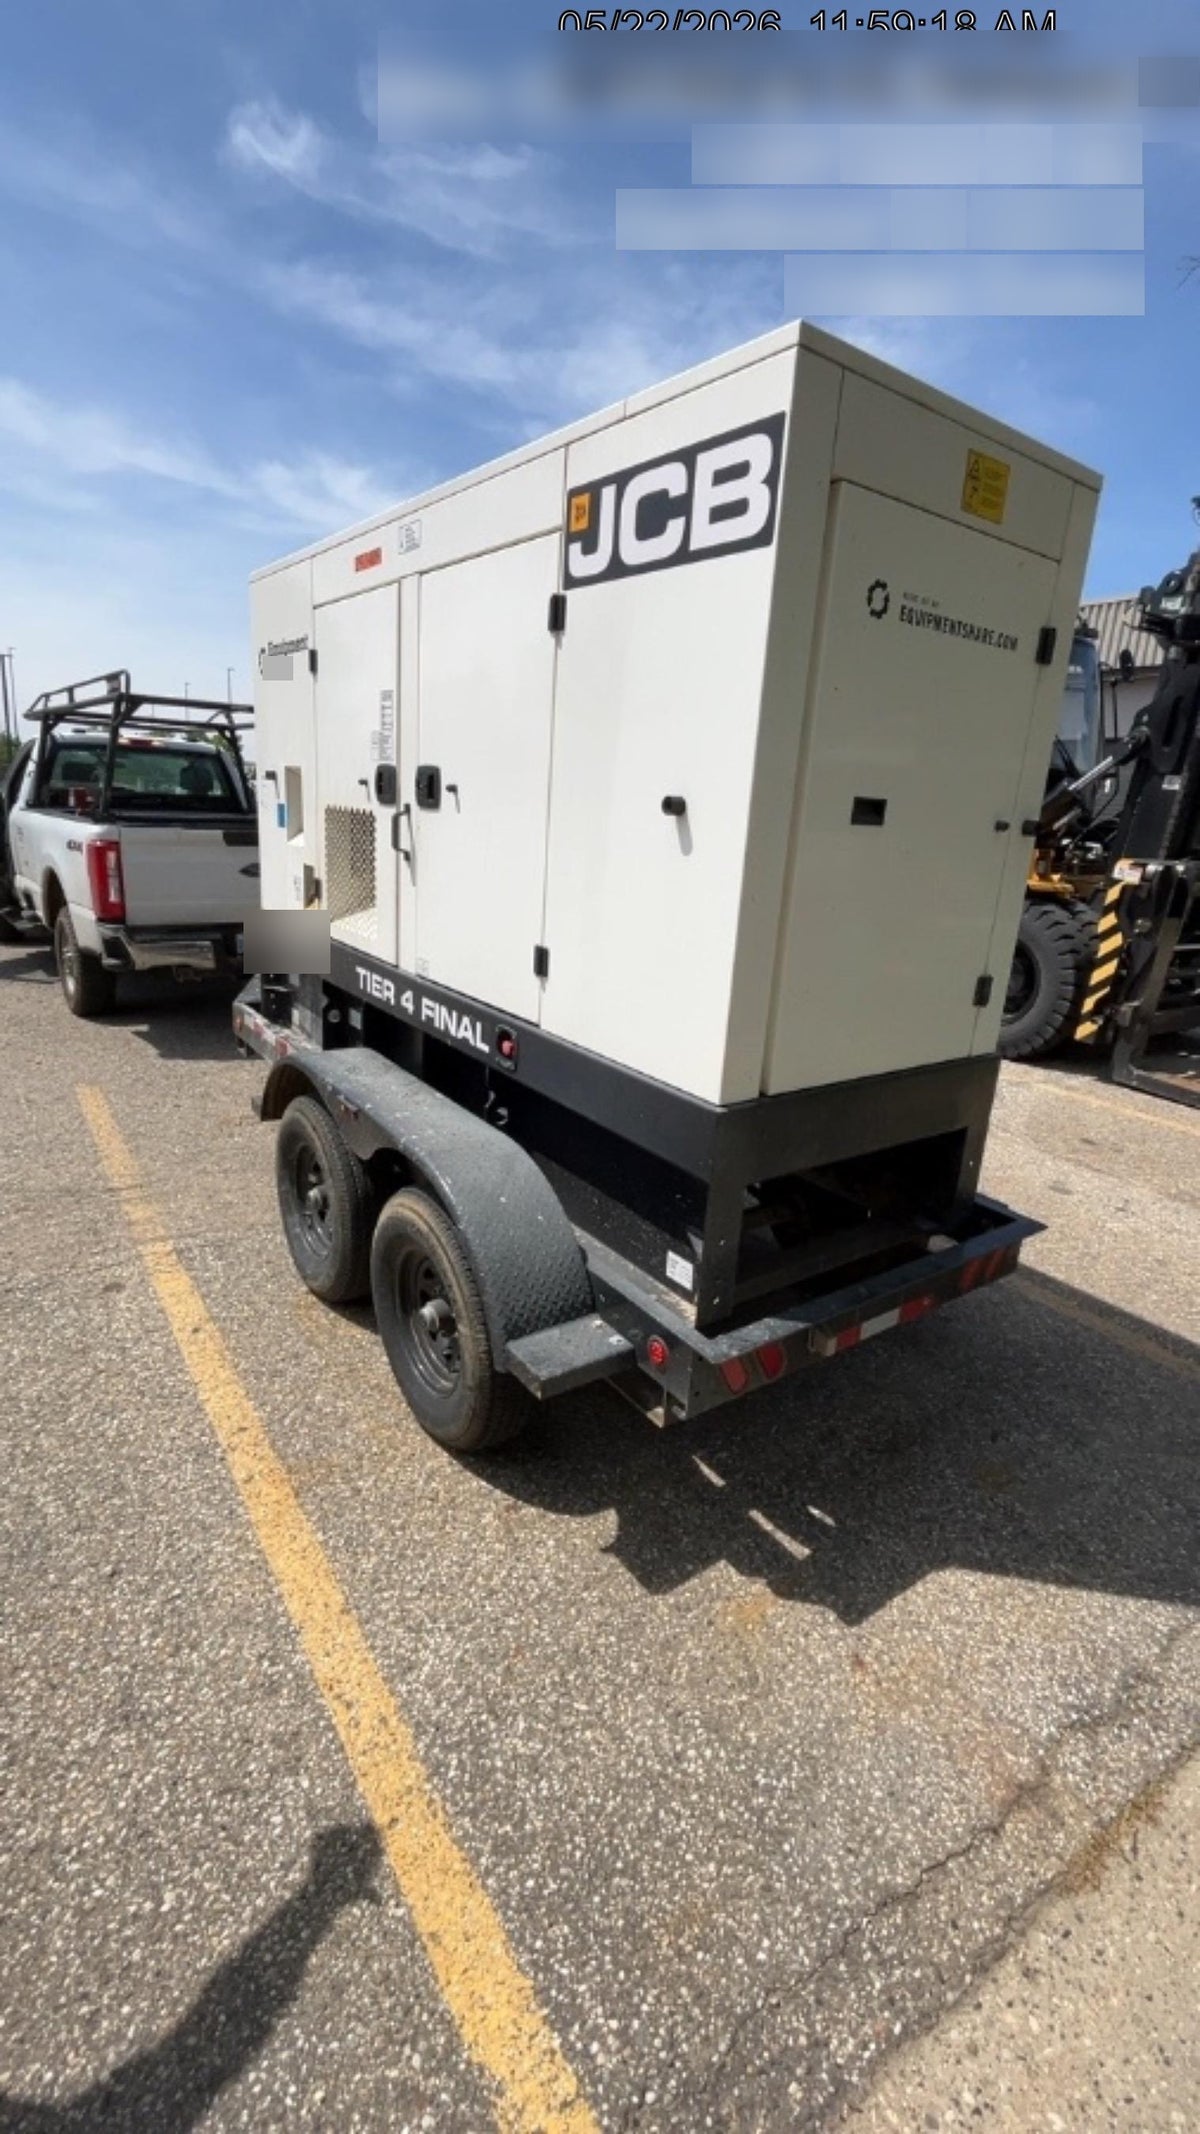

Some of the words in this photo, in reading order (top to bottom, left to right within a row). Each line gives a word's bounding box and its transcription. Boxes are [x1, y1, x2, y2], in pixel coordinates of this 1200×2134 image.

[568, 433, 773, 578] JCB
[900, 604, 1018, 651] EQUIPMENTSHARE.COM
[356, 965, 395, 1006] TIER
[401, 990, 415, 1015] 4
[421, 996, 489, 1054] FINAL
